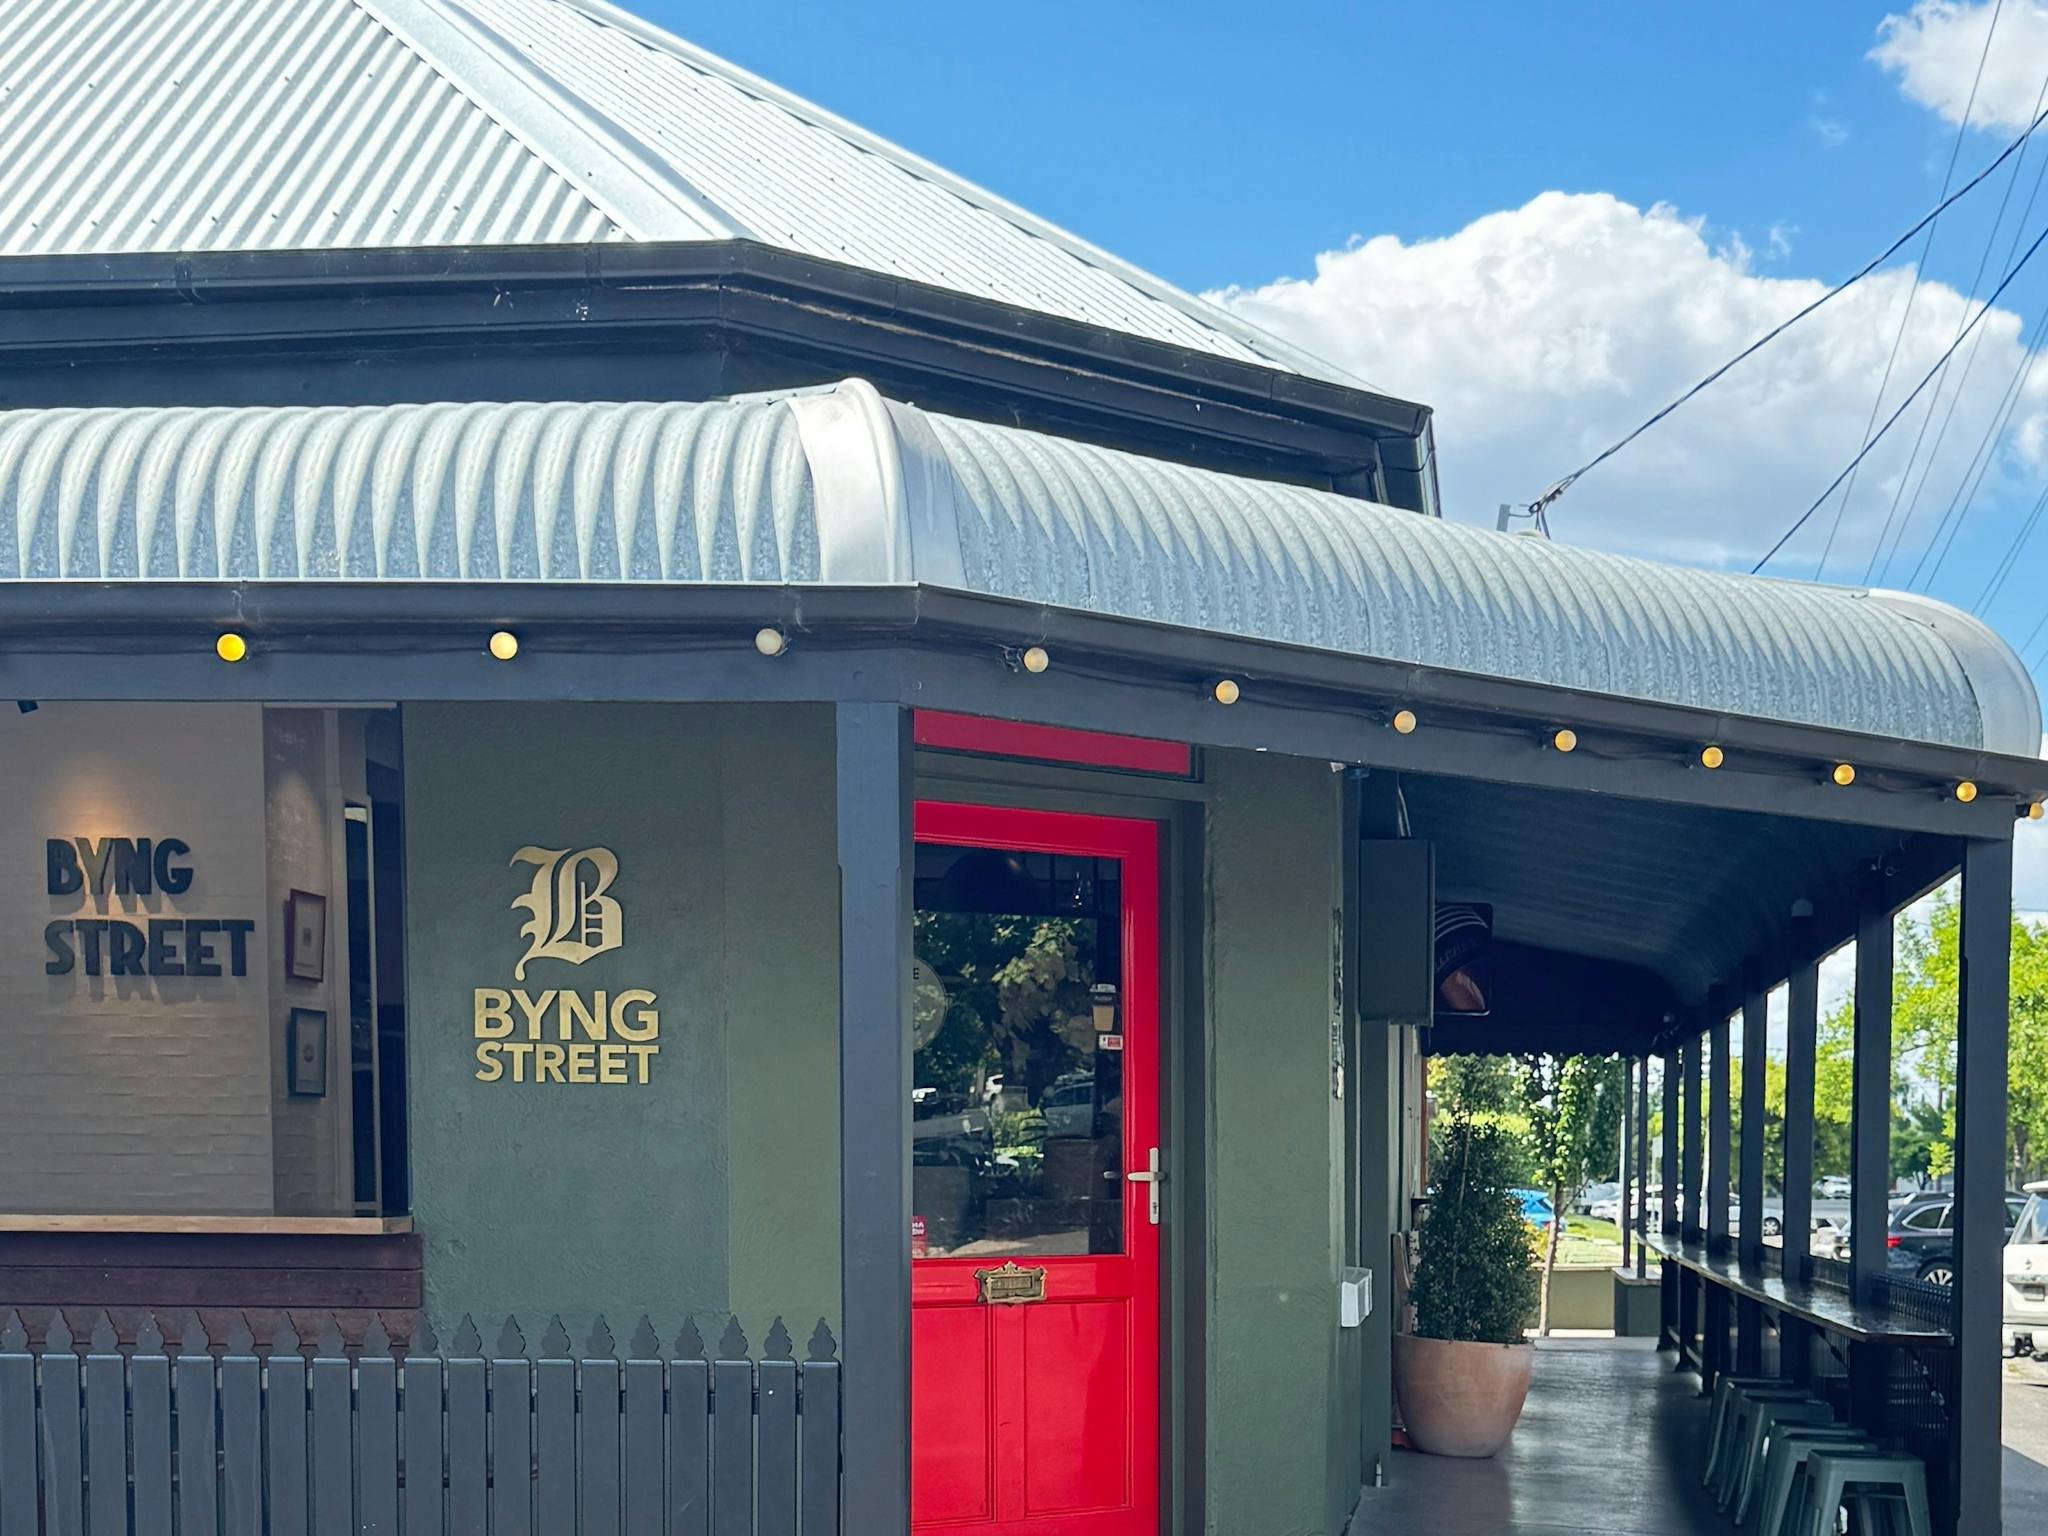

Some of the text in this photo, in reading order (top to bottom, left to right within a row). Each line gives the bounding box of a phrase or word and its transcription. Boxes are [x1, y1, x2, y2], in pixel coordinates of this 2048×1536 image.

[47, 836, 194, 895] BYNG
[509, 845, 623, 981] B
[44, 919, 255, 976] STREET
[474, 988, 659, 1041] BYNG
[475, 1041, 660, 1084] STREET
